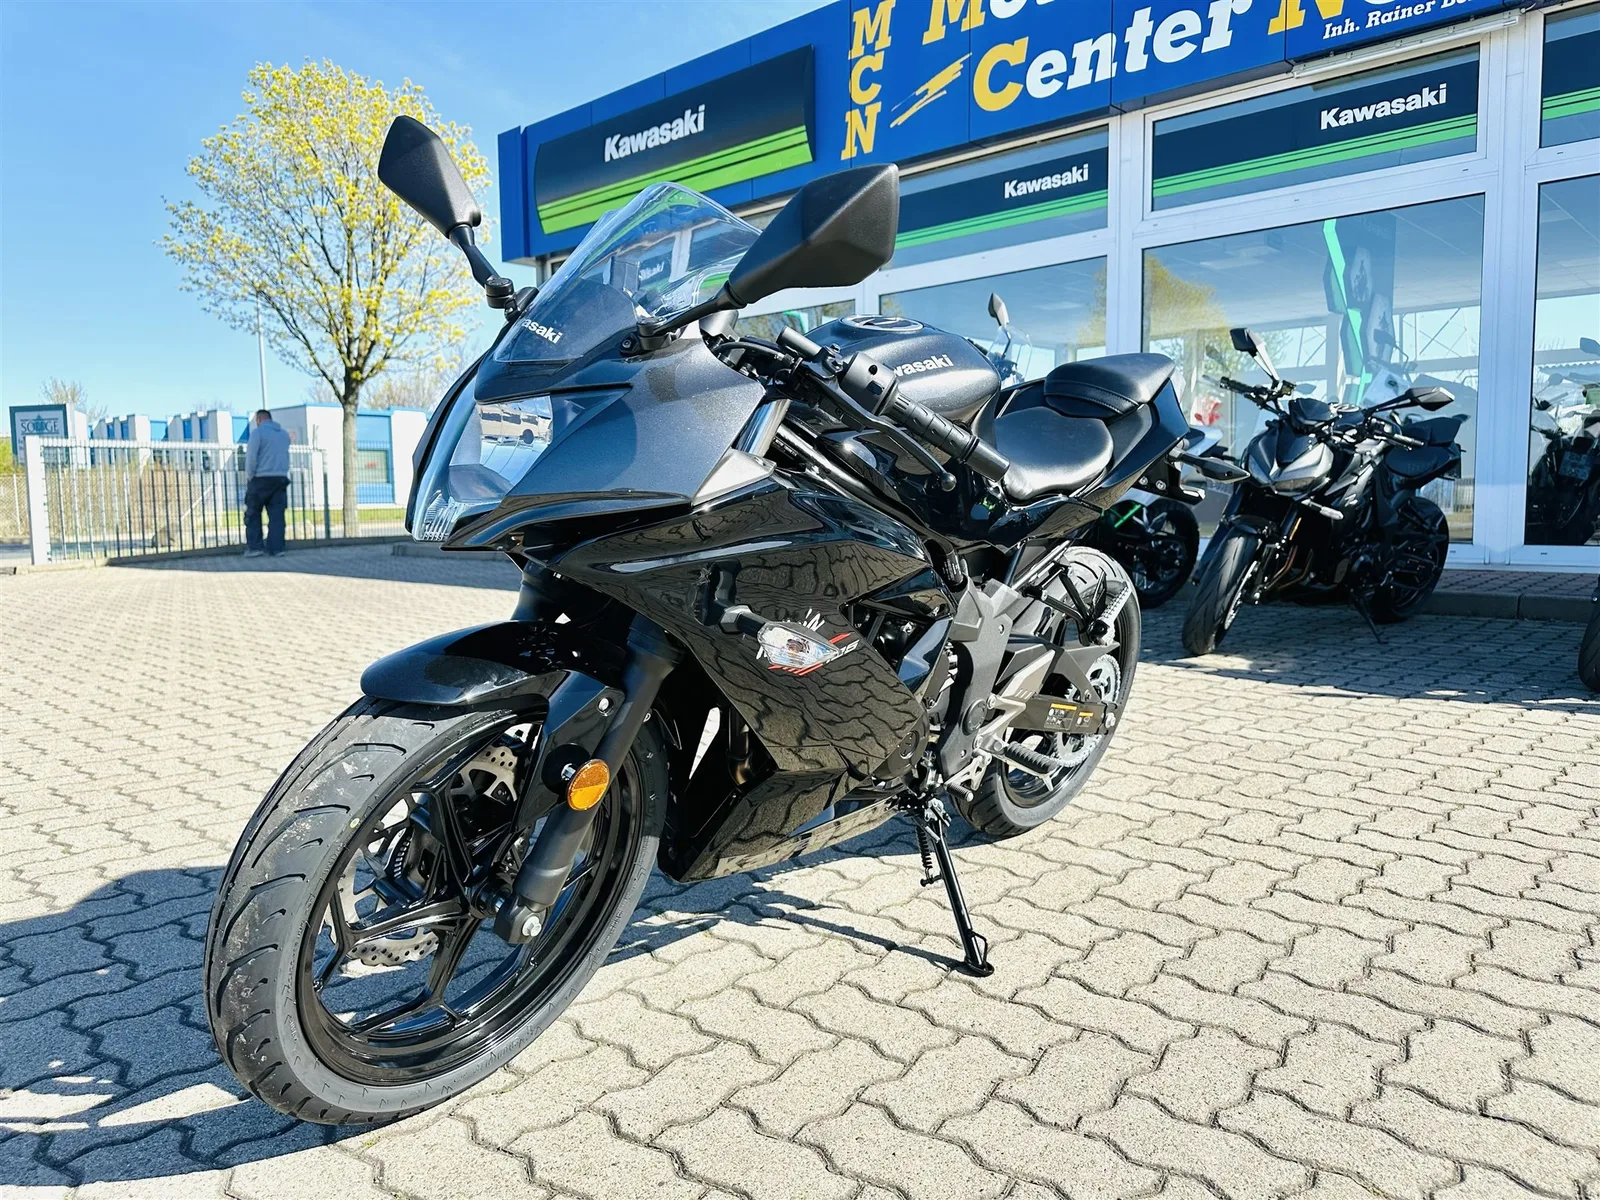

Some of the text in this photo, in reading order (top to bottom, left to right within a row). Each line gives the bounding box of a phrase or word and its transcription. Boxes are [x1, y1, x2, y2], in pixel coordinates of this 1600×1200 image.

[1322, 19, 1360, 40] Inh.
[1365, 0, 1436, 29] Rainer
[973, 0, 1251, 112] Center
[841, 0, 896, 160] MCN
[1320, 83, 1447, 130] Kawasaki
[604, 104, 706, 163] Kawasaki
[1004, 163, 1089, 199] Kawasaki
[521, 318, 563, 344] asaki
